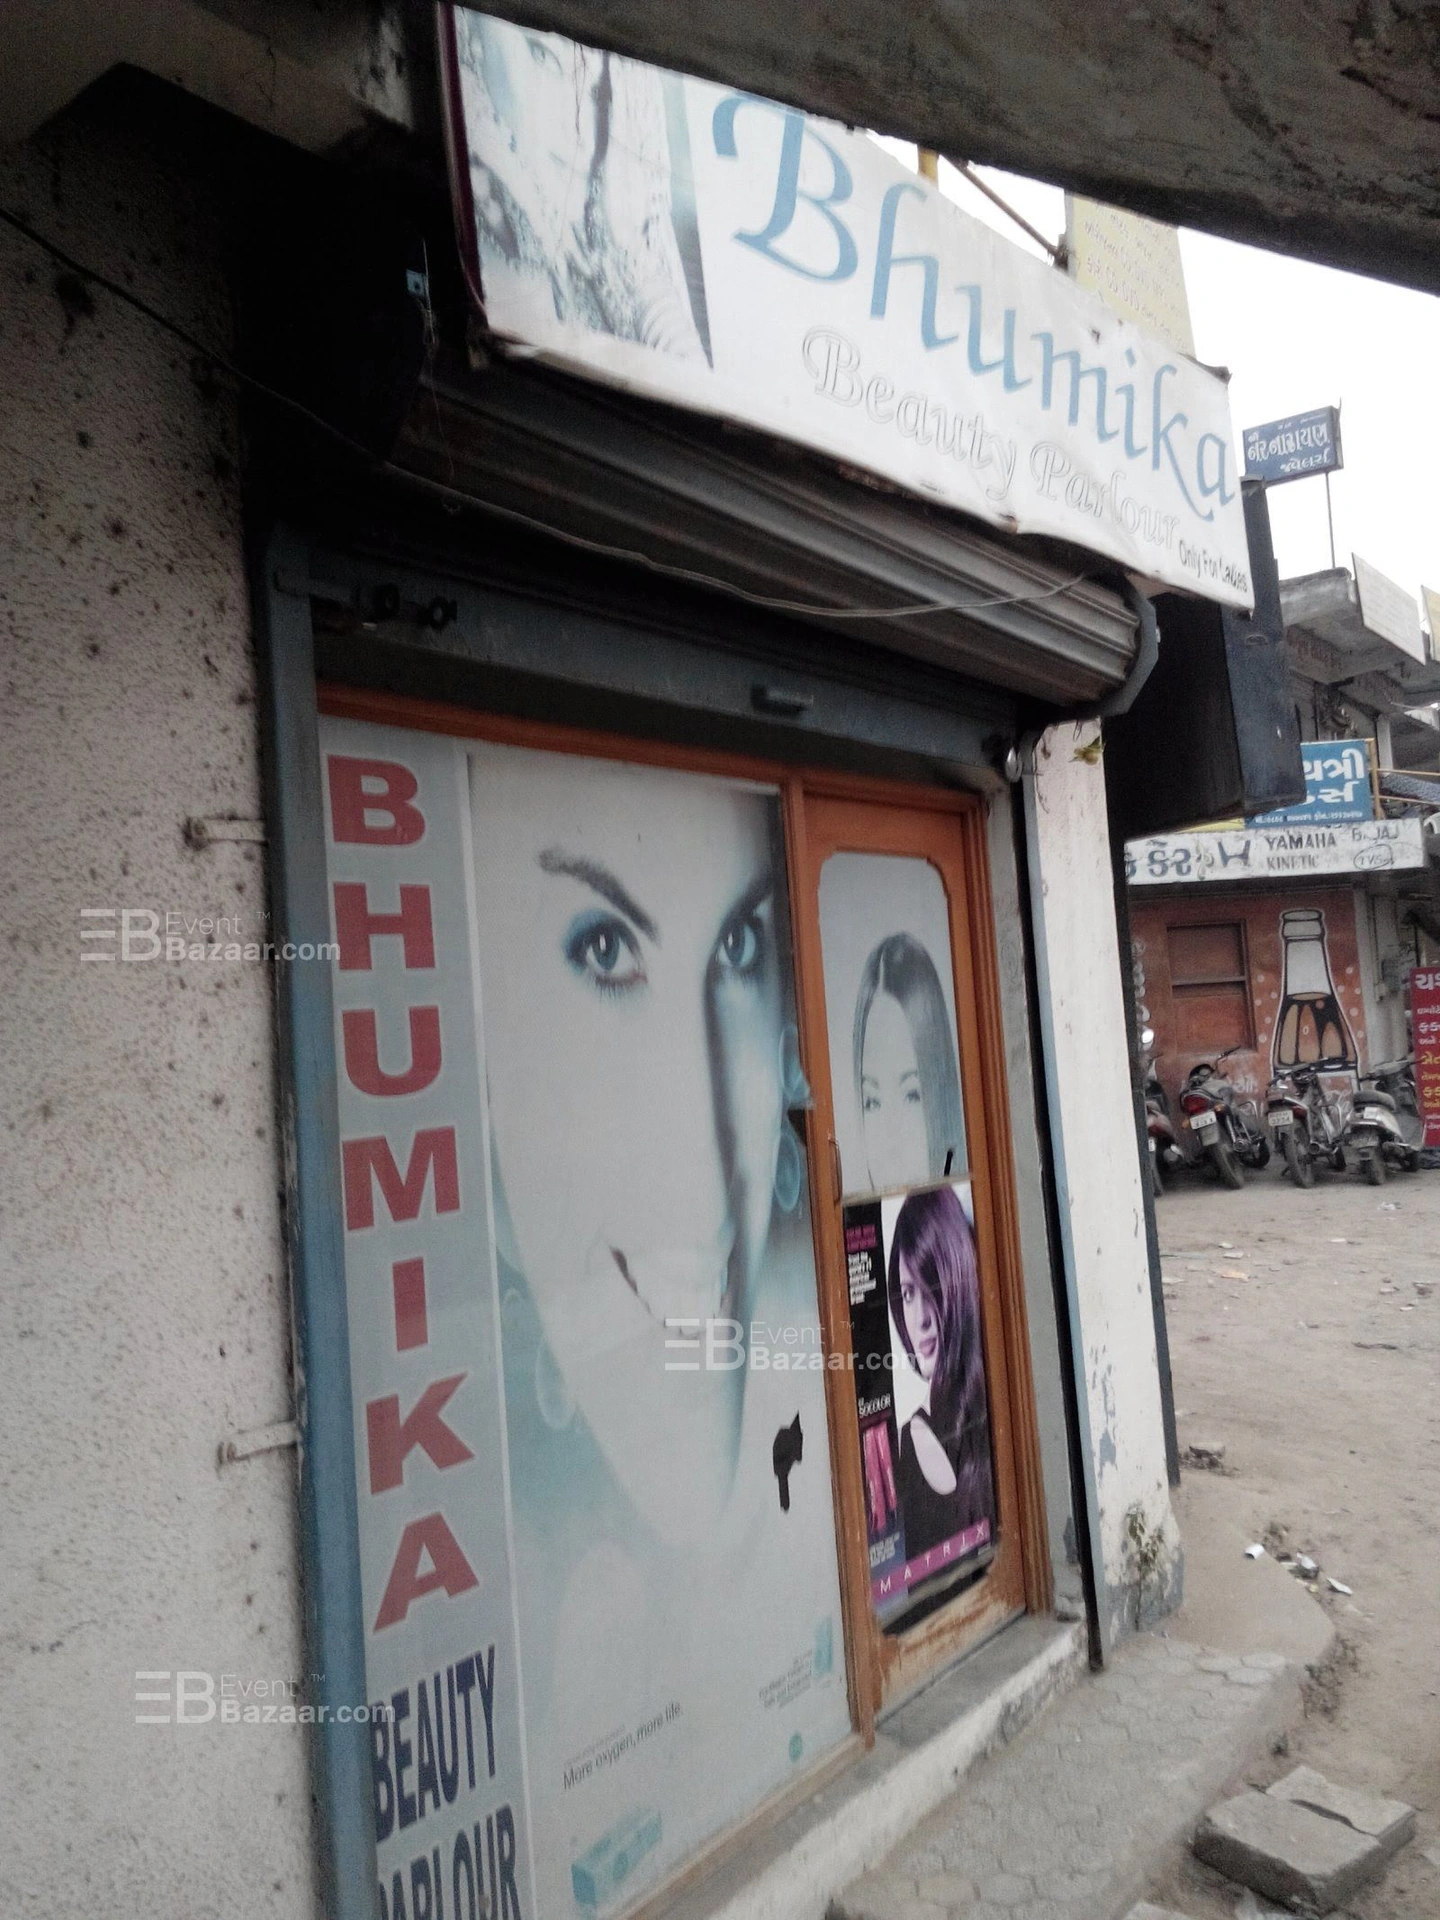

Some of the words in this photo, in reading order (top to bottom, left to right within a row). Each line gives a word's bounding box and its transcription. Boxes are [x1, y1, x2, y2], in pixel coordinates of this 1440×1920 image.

[712, 92, 1234, 522] Bhumika
[801, 325, 1017, 502] Beauty
[1029, 441, 1180, 549] Parlour
[1179, 540, 1201, 579] Only
[1265, 831, 1337, 851] YAMAHA
[1351, 824, 1400, 843] BJAJ
[1266, 854, 1320, 871] KINETIC
[327, 754, 480, 1634] BHUMIKA
[879, 1520, 986, 1596] MATRIX
[368, 1644, 496, 1844] BEAUTY
[562, 1760, 593, 1791] More
[637, 1713, 663, 1741] more
